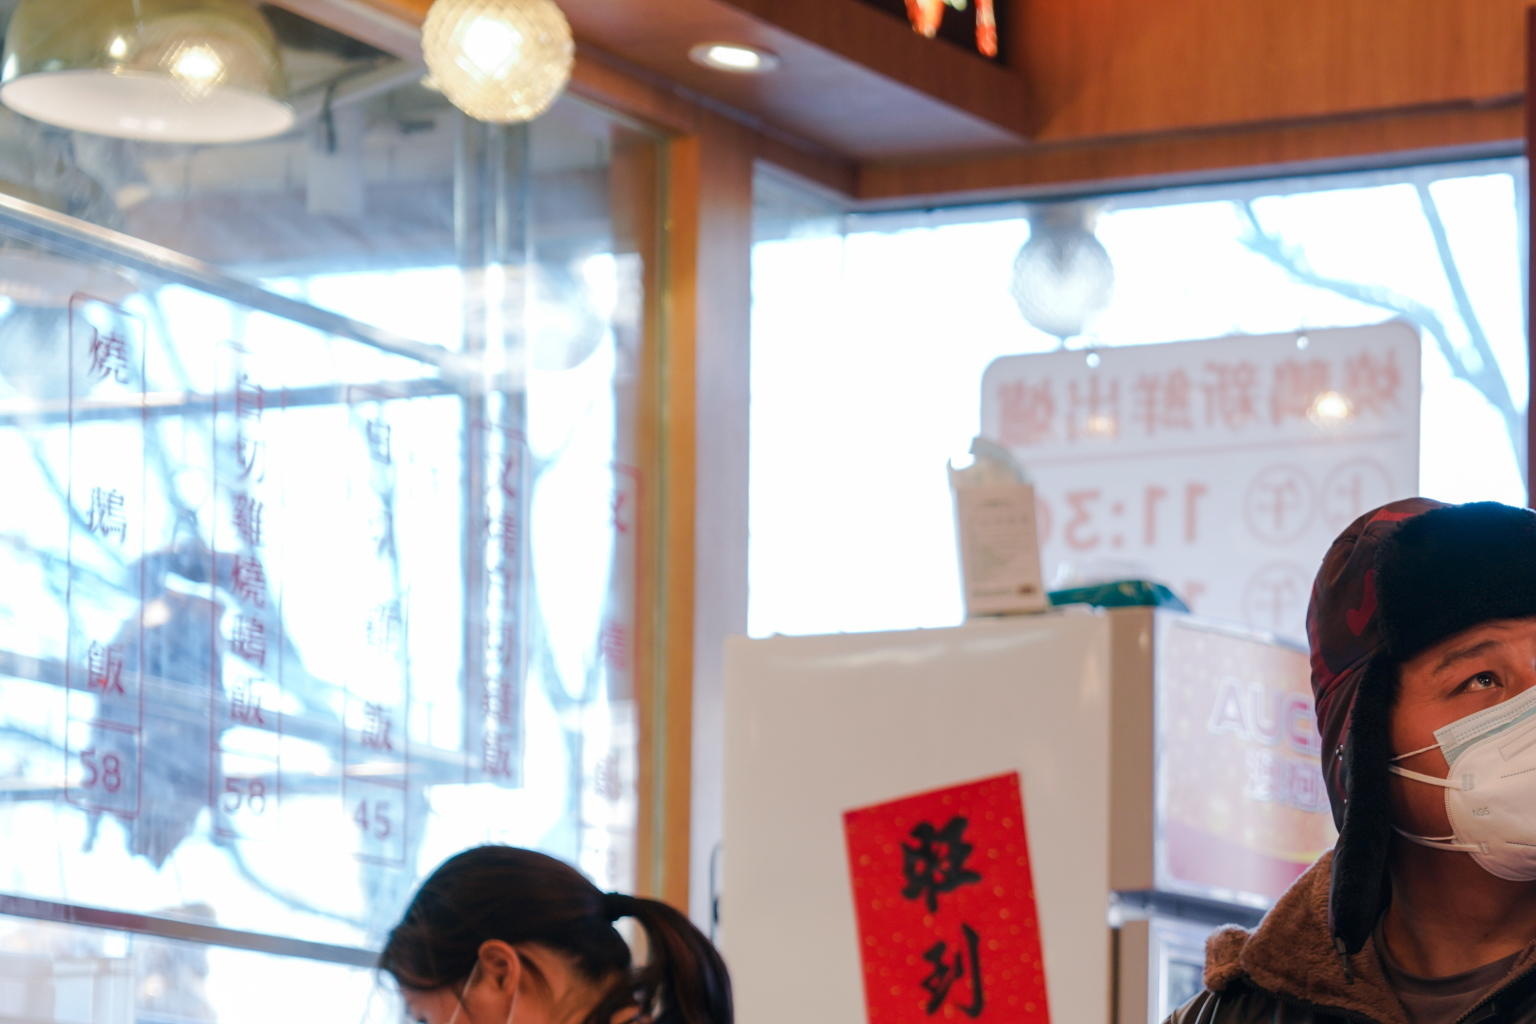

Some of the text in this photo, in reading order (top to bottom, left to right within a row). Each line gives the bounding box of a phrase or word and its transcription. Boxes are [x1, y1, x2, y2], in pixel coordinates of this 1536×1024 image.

[80, 749, 121, 794] 58
[225, 777, 266, 815] 58
[353, 799, 391, 841] 45
